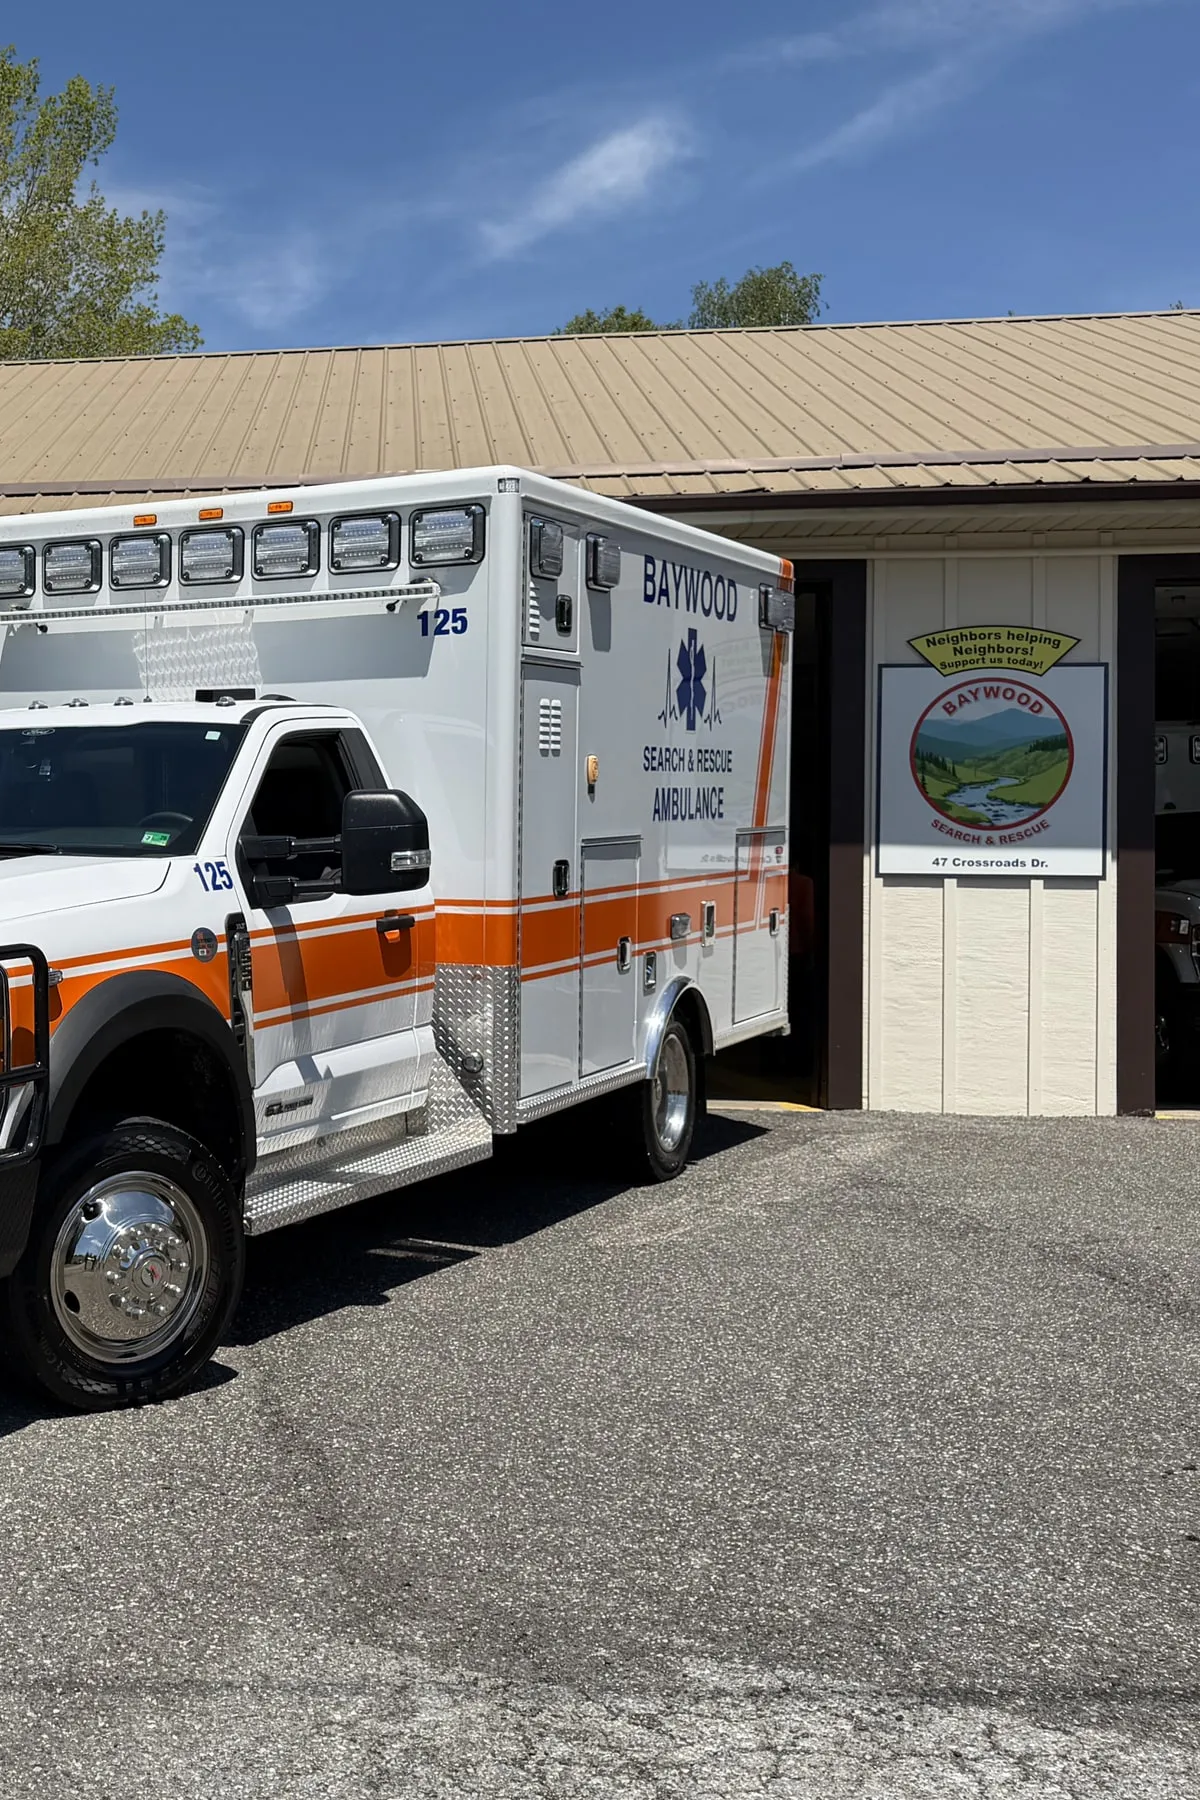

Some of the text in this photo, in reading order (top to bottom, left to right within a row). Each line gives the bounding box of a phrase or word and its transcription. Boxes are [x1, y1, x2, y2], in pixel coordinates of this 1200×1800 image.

[644, 554, 737, 622] BAYWOOD
[417, 608, 468, 636] 125
[925, 630, 1062, 649] Neighbors helping
[952, 644, 1034, 656] Neighbors!
[939, 656, 986, 670] Support
[1006, 656, 1044, 669] today!
[941, 686, 1044, 716] BAYWOOD
[643, 746, 732, 773] SEARCH & RESCUE
[652, 787, 724, 822] AMBULANCE
[930, 819, 1050, 845] SEARCH & RESCUE
[193, 861, 233, 892] 125
[932, 858, 1049, 868] 47 Crossroads Dr.
